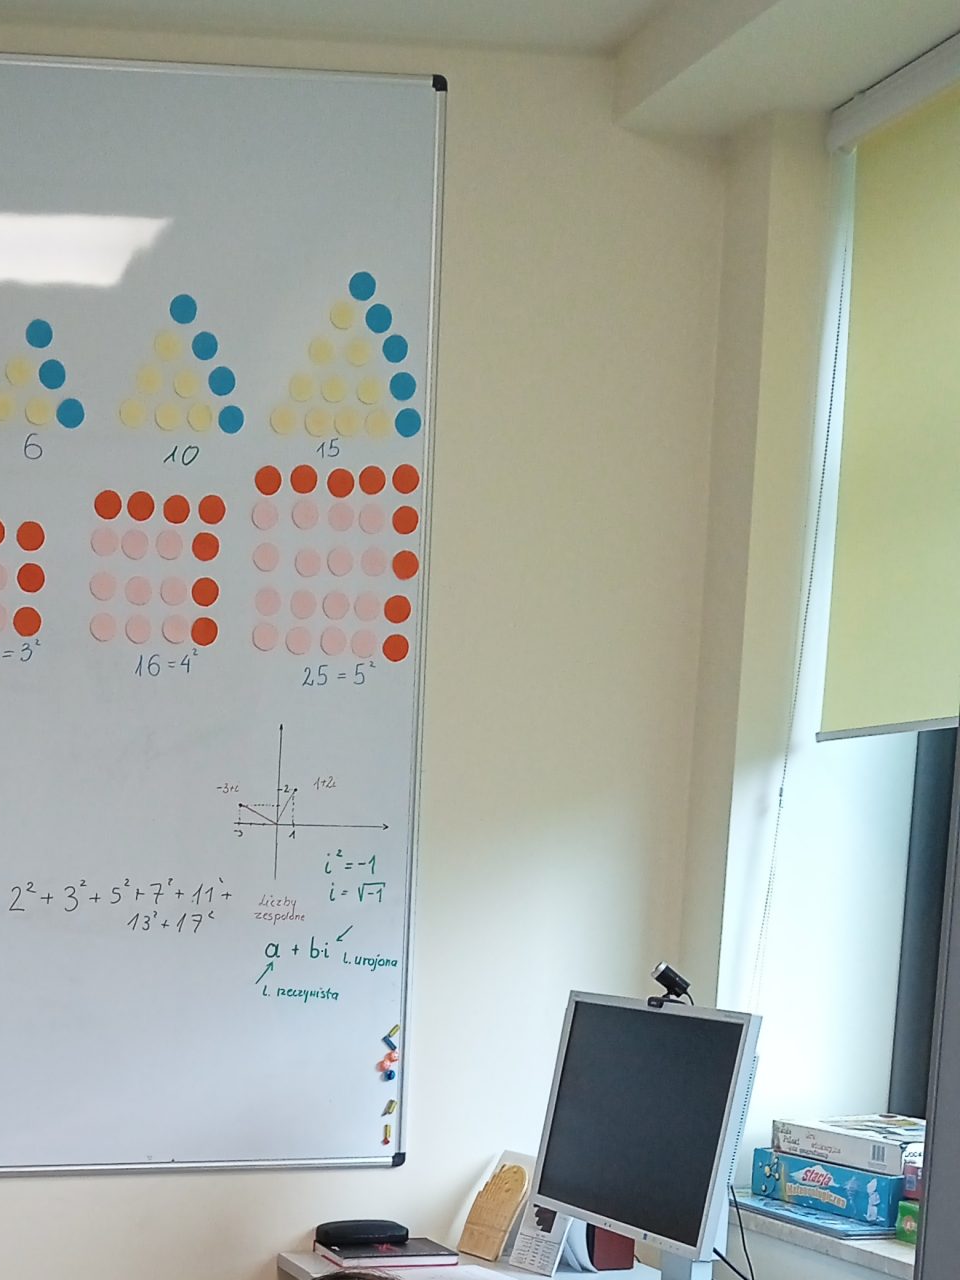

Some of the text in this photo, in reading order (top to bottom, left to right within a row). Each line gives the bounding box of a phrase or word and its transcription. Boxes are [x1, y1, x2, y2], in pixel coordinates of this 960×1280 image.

[23, 432, 44, 460] 6
[163, 445, 200, 466] 10
[316, 437, 341, 459] 15
[288, 829, 296, 840] 1
[258, 893, 298, 914] Liczby
[354, 953, 398, 973] urojona
